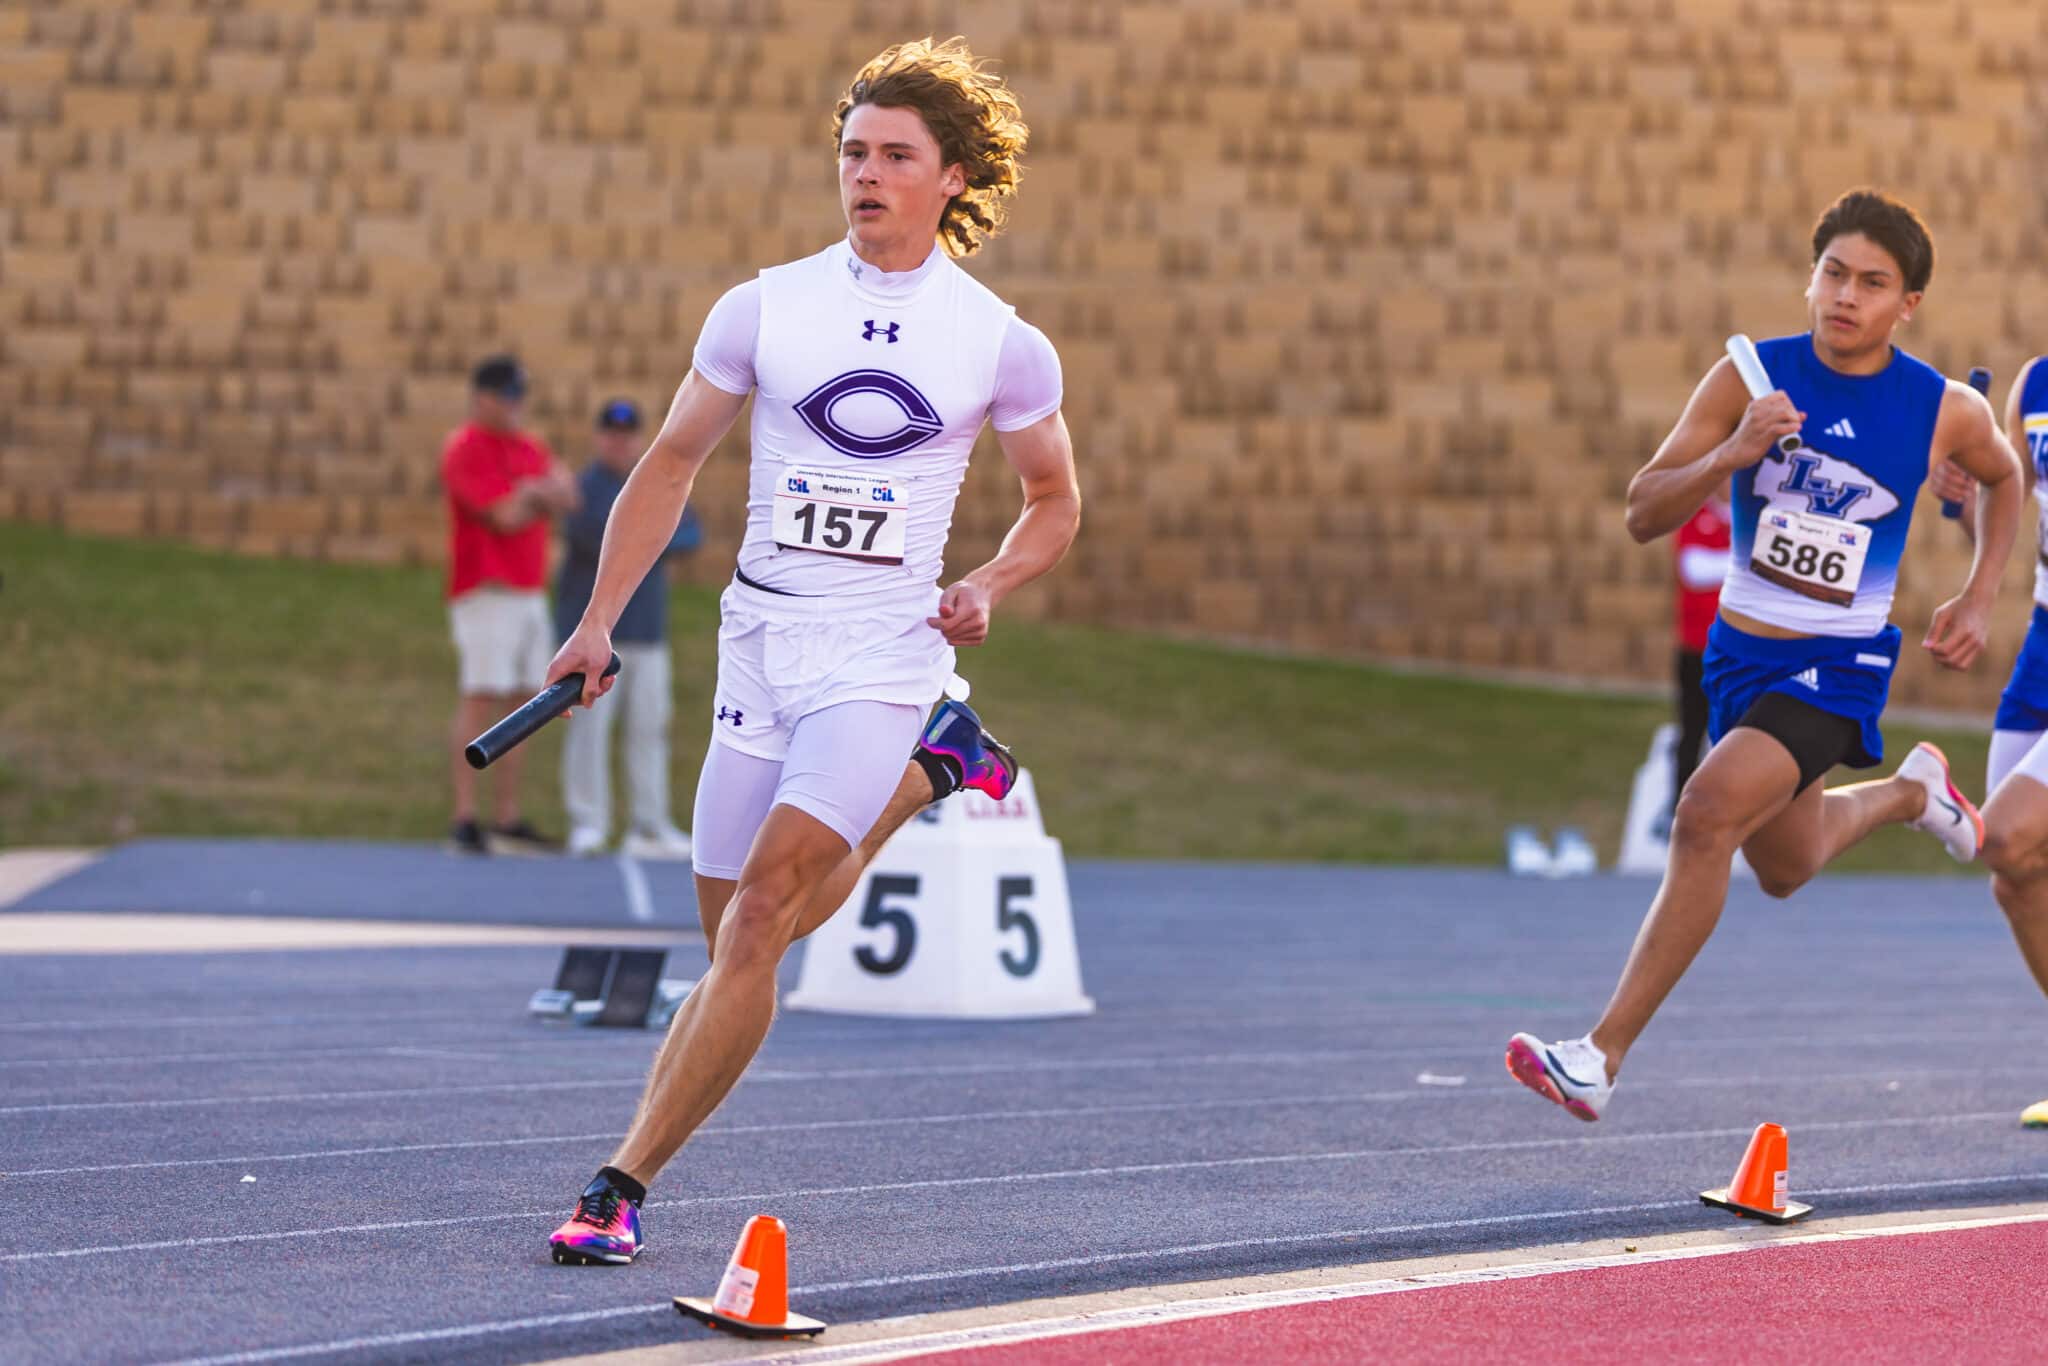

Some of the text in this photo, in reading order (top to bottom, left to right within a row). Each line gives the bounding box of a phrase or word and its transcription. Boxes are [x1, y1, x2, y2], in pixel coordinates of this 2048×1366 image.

[792, 369, 944, 459] C
[822, 484, 853, 494] Region
[794, 502, 888, 551] 157
[1767, 534, 1847, 583] 586
[853, 873, 921, 976] 5
[997, 875, 1041, 978] 5
